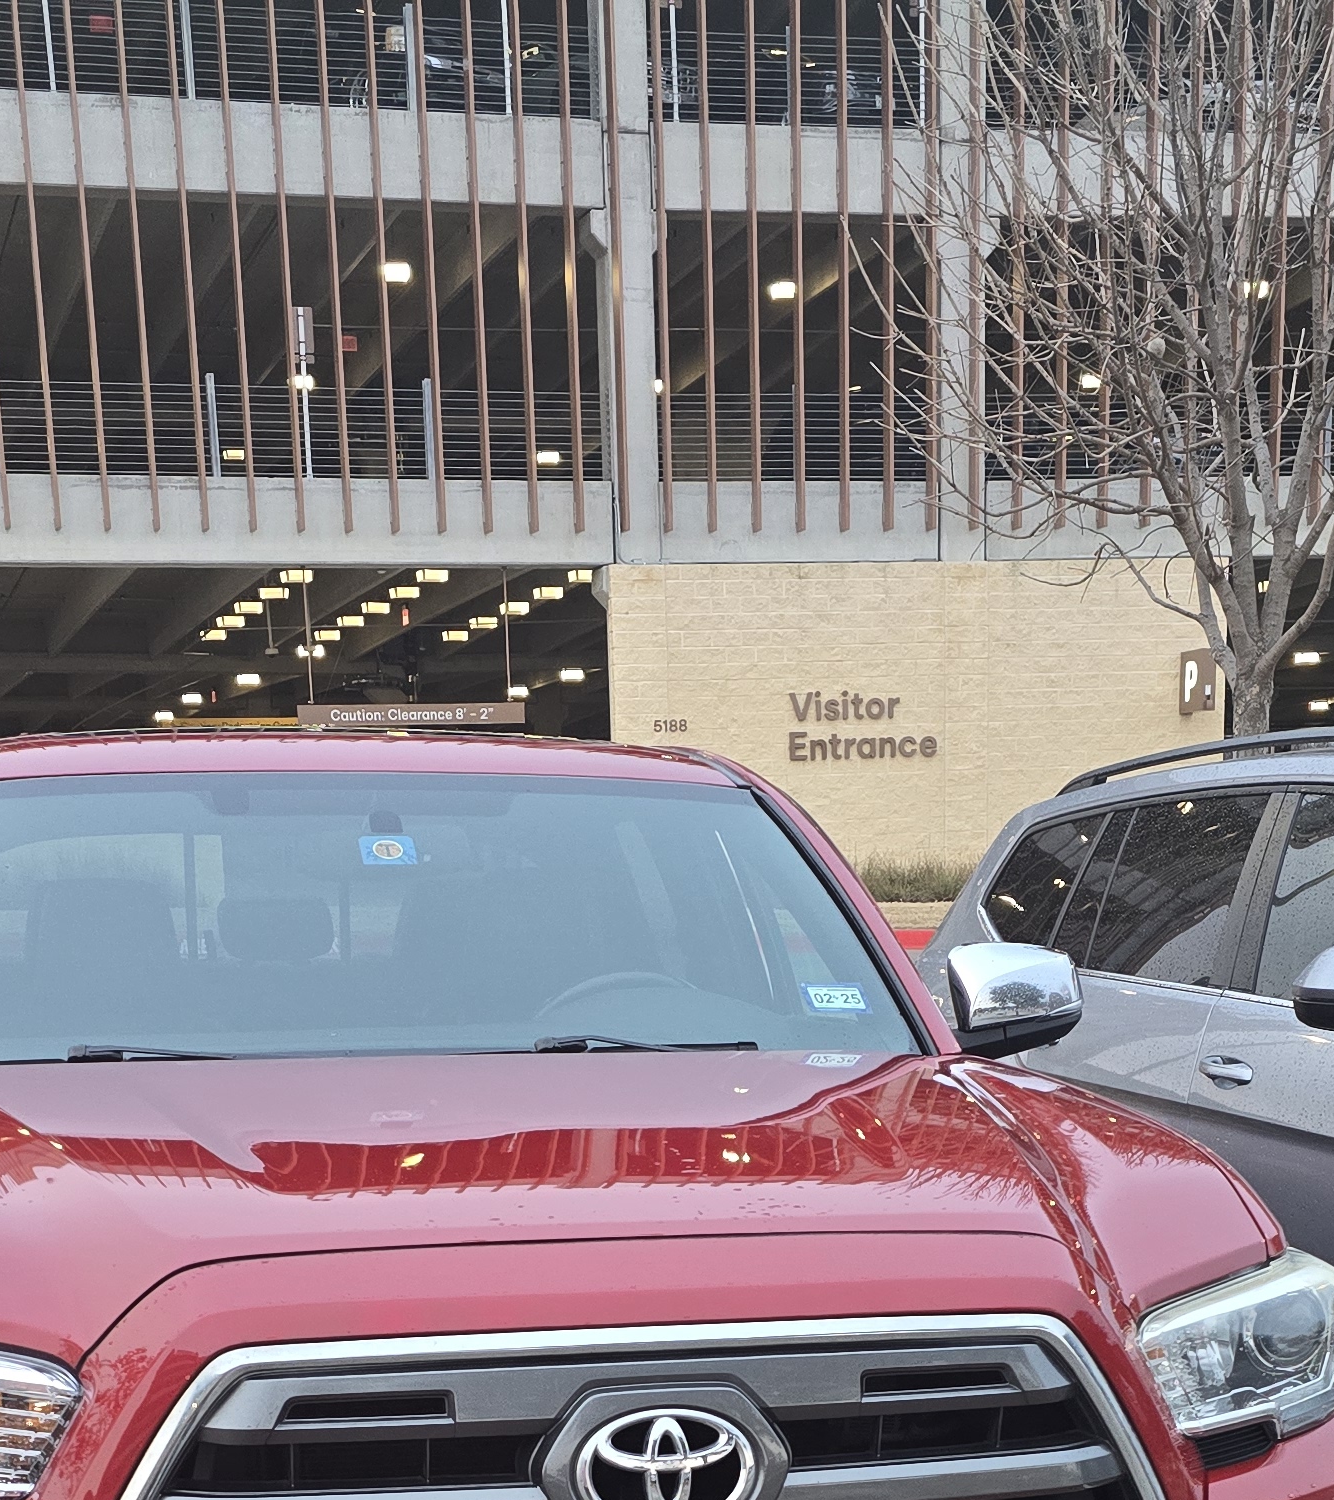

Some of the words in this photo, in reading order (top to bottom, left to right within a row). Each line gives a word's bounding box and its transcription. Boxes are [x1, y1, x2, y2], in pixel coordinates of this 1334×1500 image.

[330, 709, 385, 722] Caution:
[387, 708, 452, 722] Clearance
[788, 690, 900, 722] Visitor
[653, 719, 688, 733] 5188
[788, 731, 938, 762] Entrance
